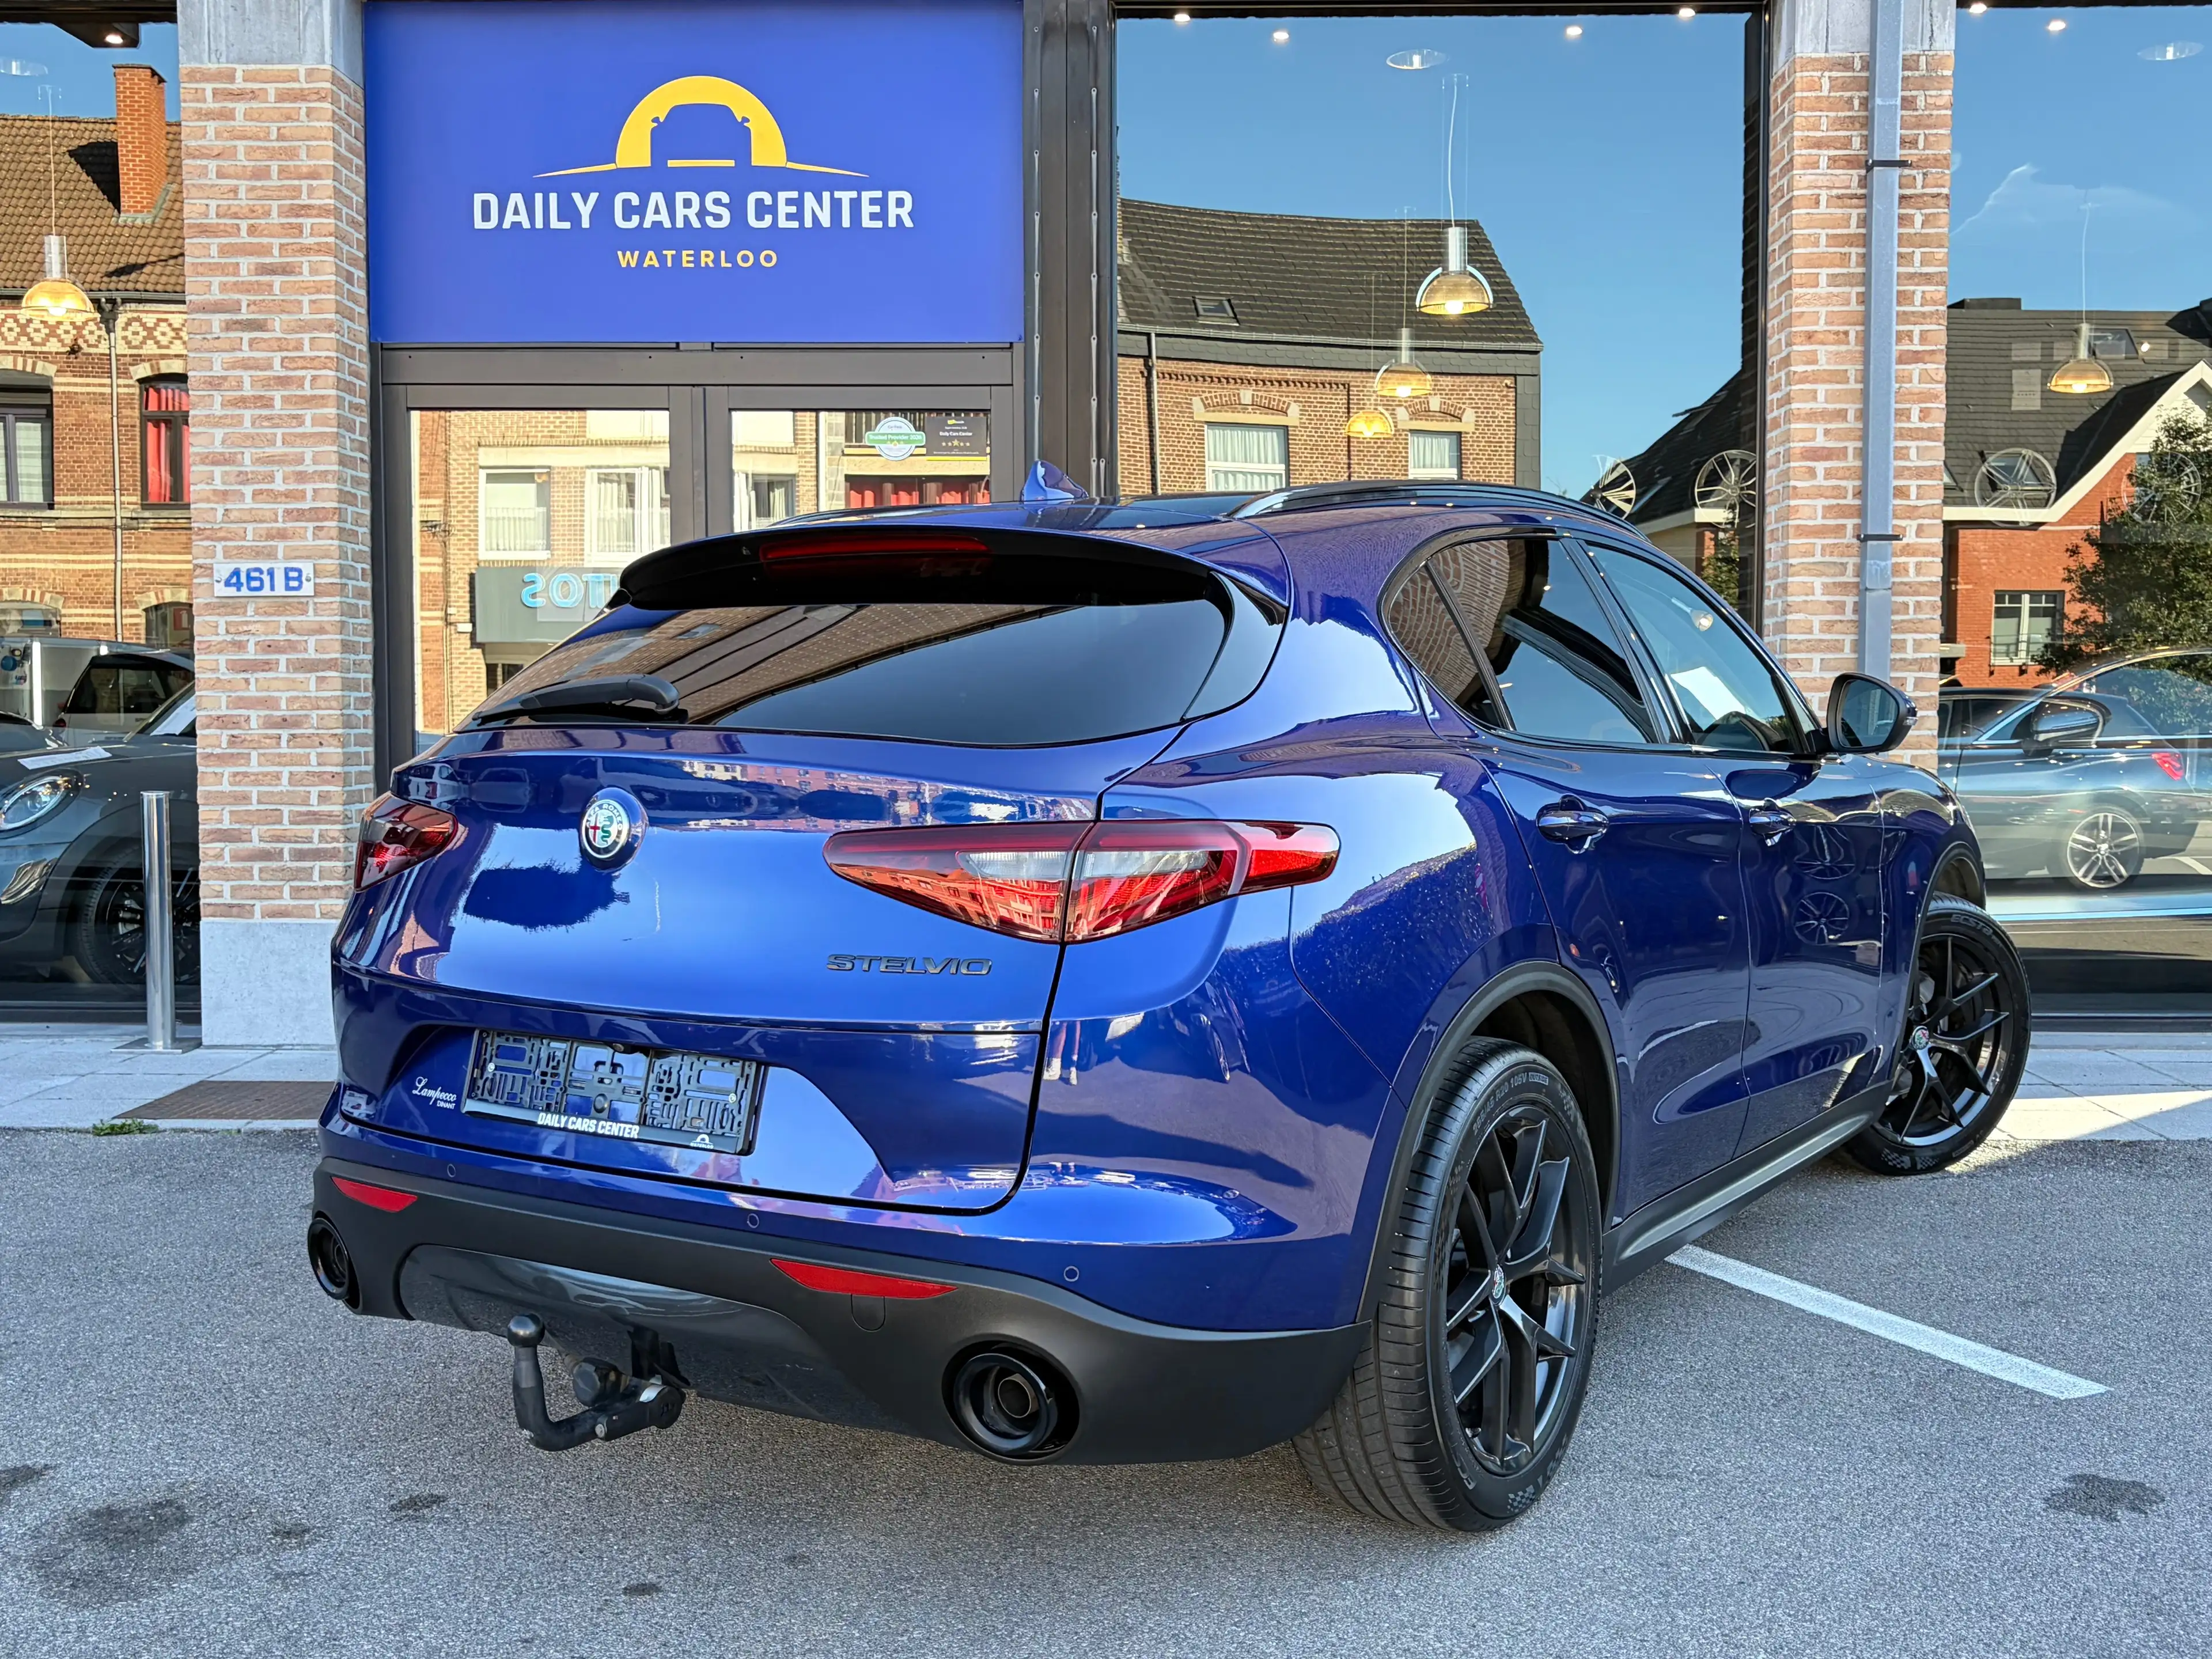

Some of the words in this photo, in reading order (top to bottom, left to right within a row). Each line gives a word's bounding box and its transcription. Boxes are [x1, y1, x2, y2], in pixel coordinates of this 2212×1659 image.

[473, 192, 599, 230] DAILY
[613, 191, 731, 229] CARS
[747, 190, 914, 229] CENTER
[617, 249, 778, 268] WATERLOO
[224, 566, 275, 592] 461
[283, 566, 304, 592] B
[603, 803, 623, 831] ROMEO
[826, 954, 993, 975] STELVIO
[437, 1100, 456, 1109] DINANT
[537, 1112, 568, 1128] DAILY
[567, 1116, 597, 1132] CARS
[597, 1120, 640, 1139] CENTER
